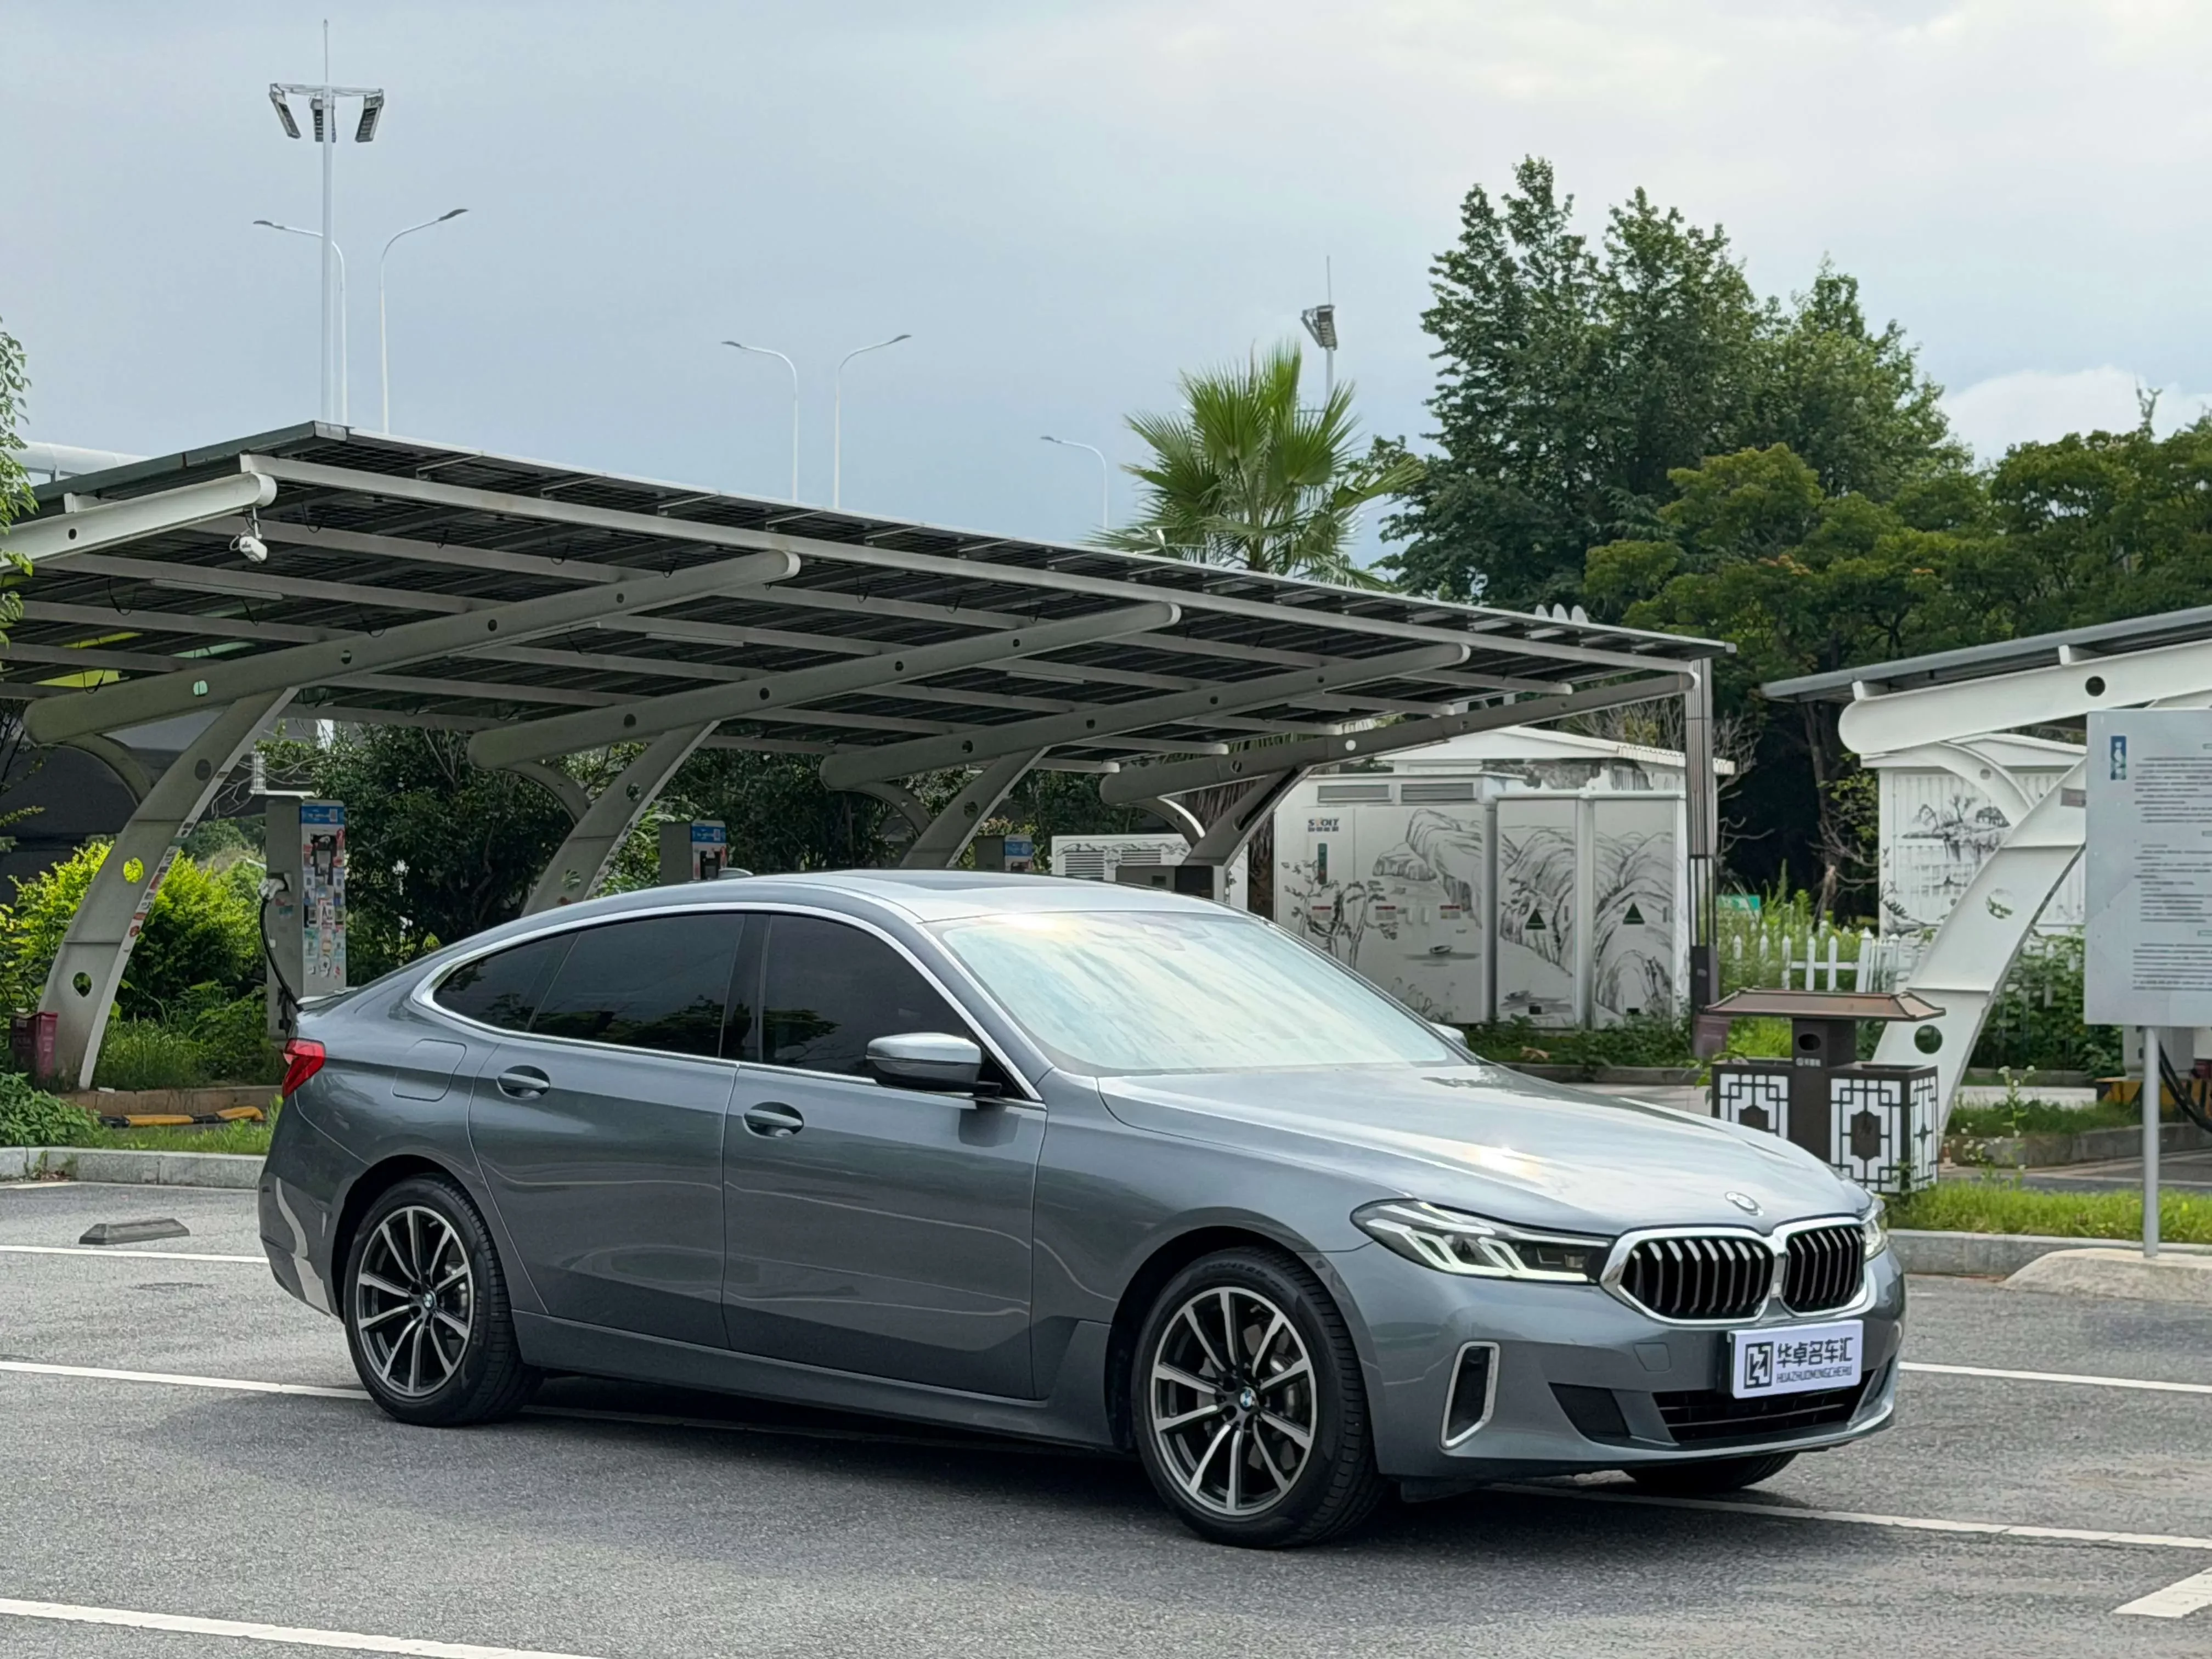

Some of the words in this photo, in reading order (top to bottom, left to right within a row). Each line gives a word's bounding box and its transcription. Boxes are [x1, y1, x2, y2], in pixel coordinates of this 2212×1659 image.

[1777, 1338, 1853, 1368] 华卓名车汇
